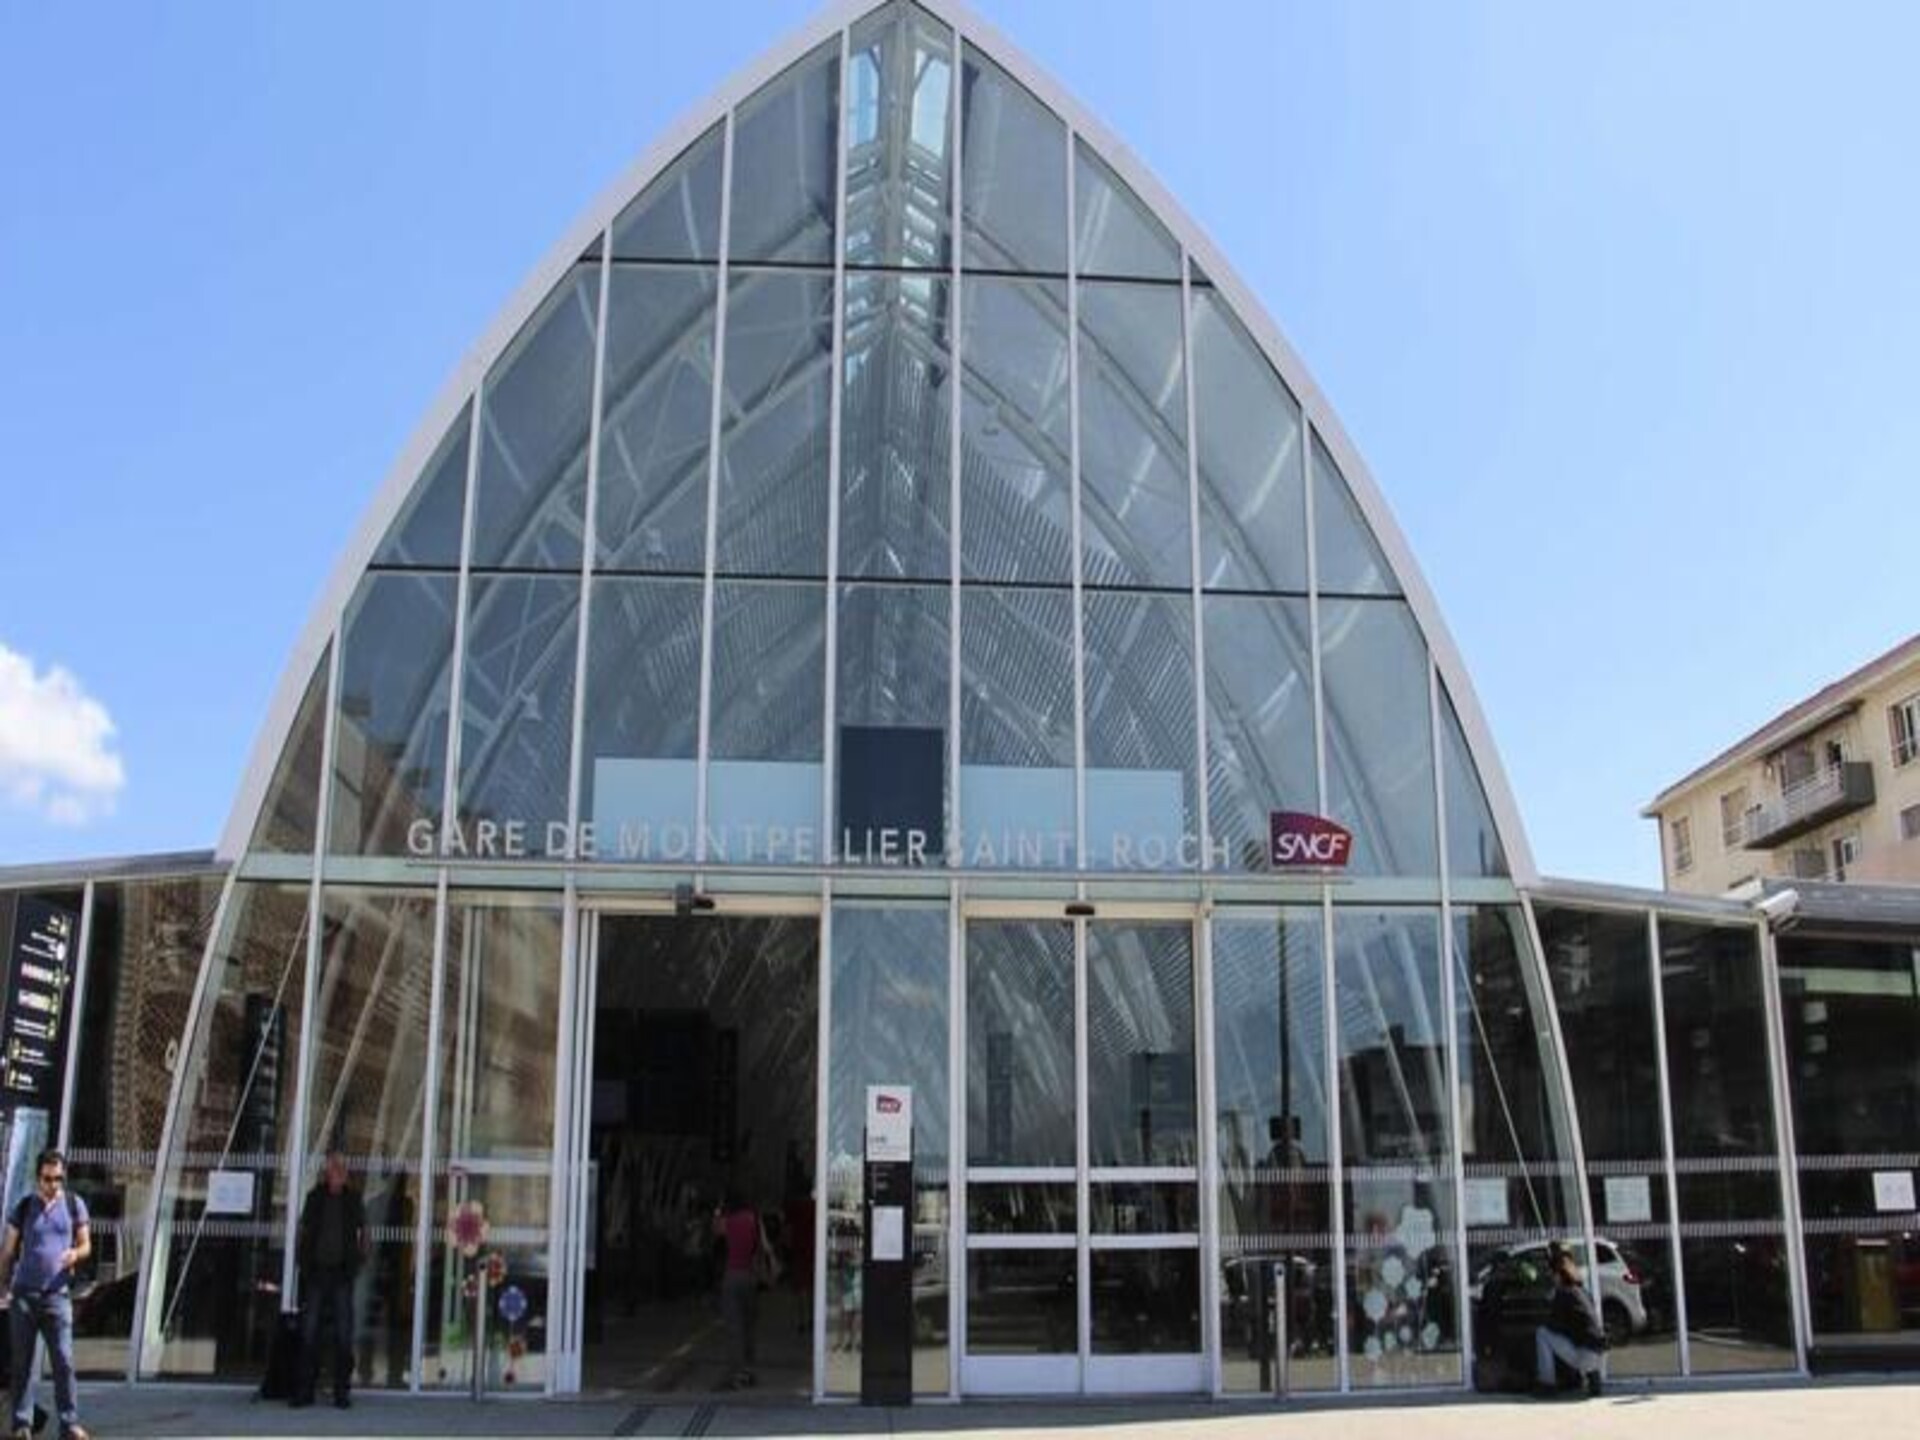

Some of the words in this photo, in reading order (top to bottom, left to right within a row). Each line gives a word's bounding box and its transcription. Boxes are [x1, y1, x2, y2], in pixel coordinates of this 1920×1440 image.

[407, 819, 525, 856] GARE
[546, 821, 598, 857] DE
[1274, 832, 1347, 860] SNCF
